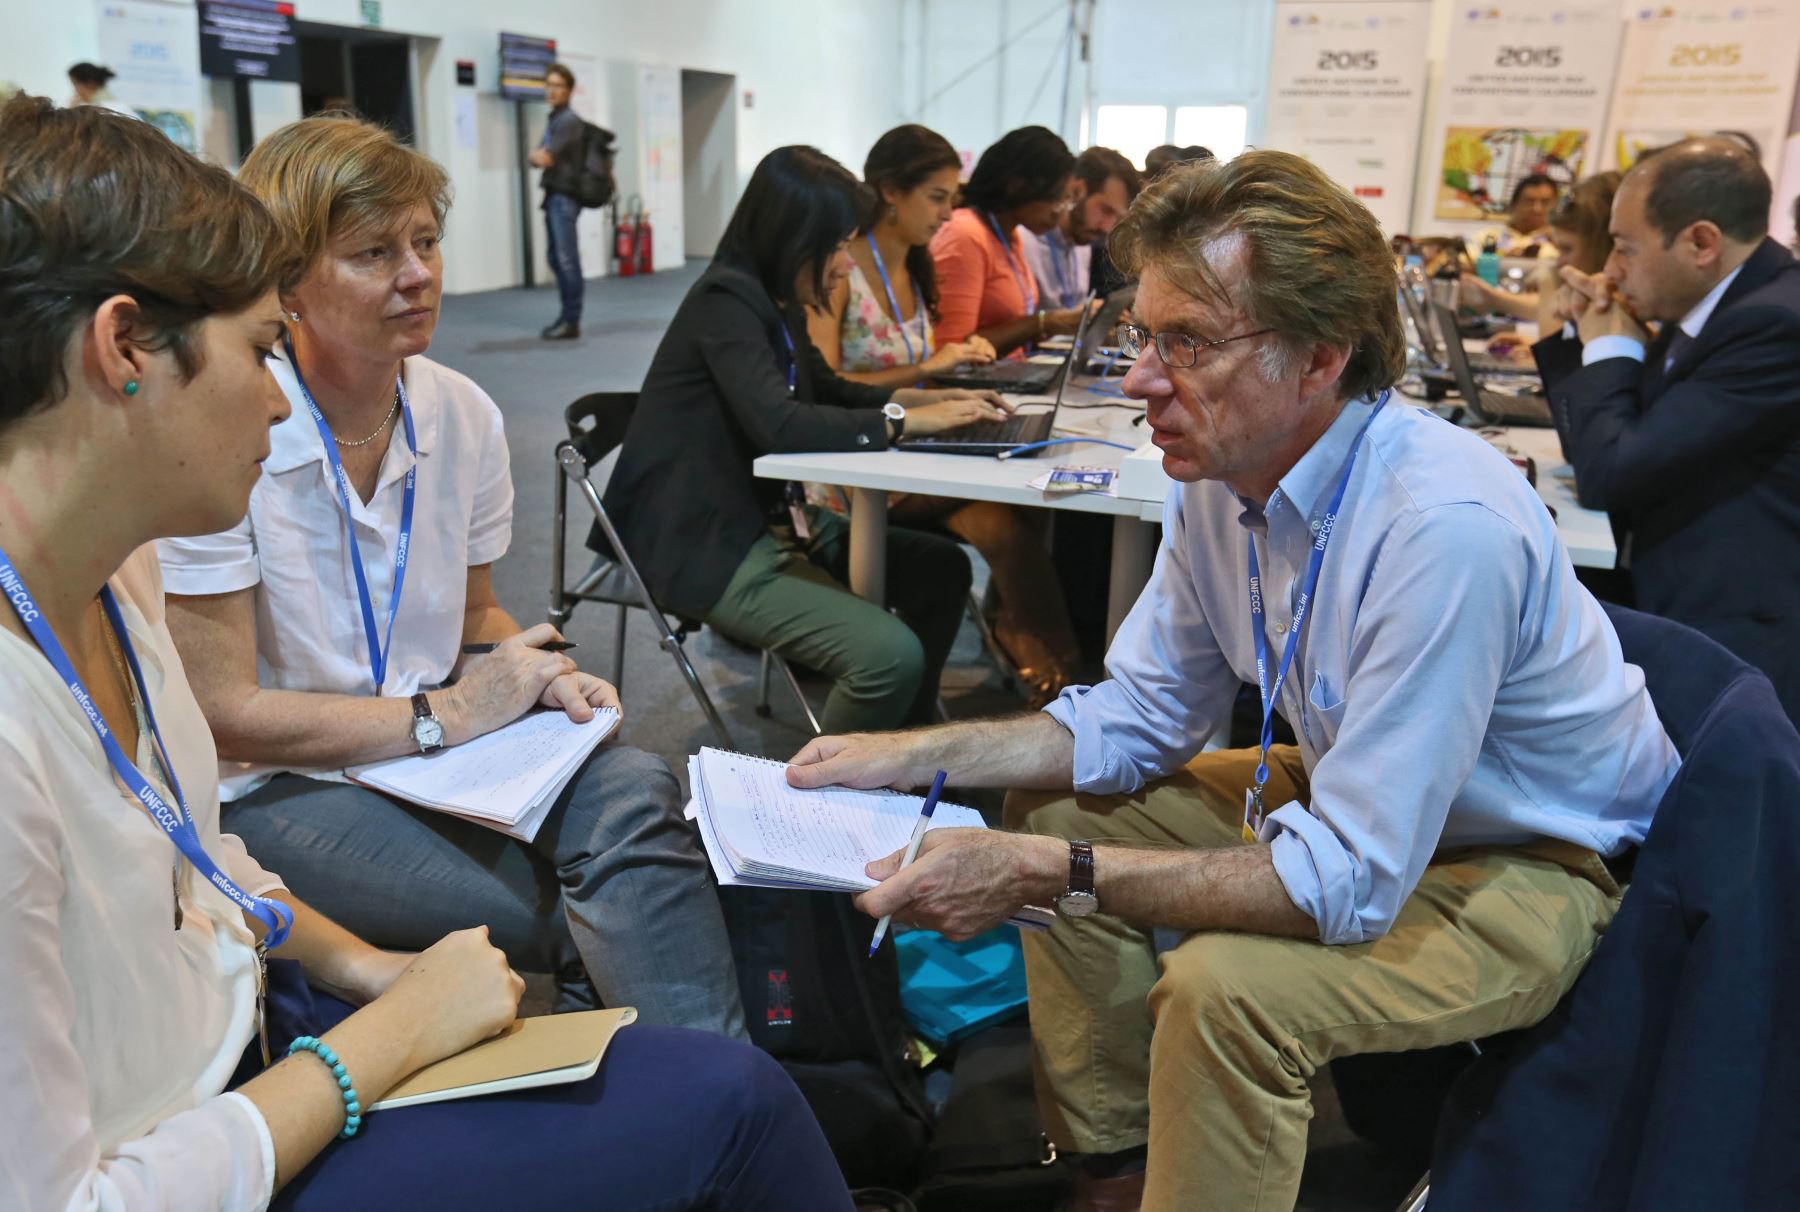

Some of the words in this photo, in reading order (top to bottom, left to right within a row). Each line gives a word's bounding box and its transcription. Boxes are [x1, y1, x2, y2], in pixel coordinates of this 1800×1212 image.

[1317, 49, 1379, 71] 2015
[1496, 45, 1562, 68] 2015
[1669, 42, 1743, 67] 2015
[396, 532, 409, 568] UNFCCC
[1314, 512, 1336, 551] UNFCCC
[1291, 593, 1308, 633] unfccc.int
[1250, 576, 1261, 614] UNFCCC
[1257, 658, 1267, 699] unfccc.int
[0, 564, 39, 622] UNFCCC
[71, 682, 109, 738] unfccc.int
[140, 785, 178, 833] UNFCCC
[212, 871, 256, 911] unfccc.int
